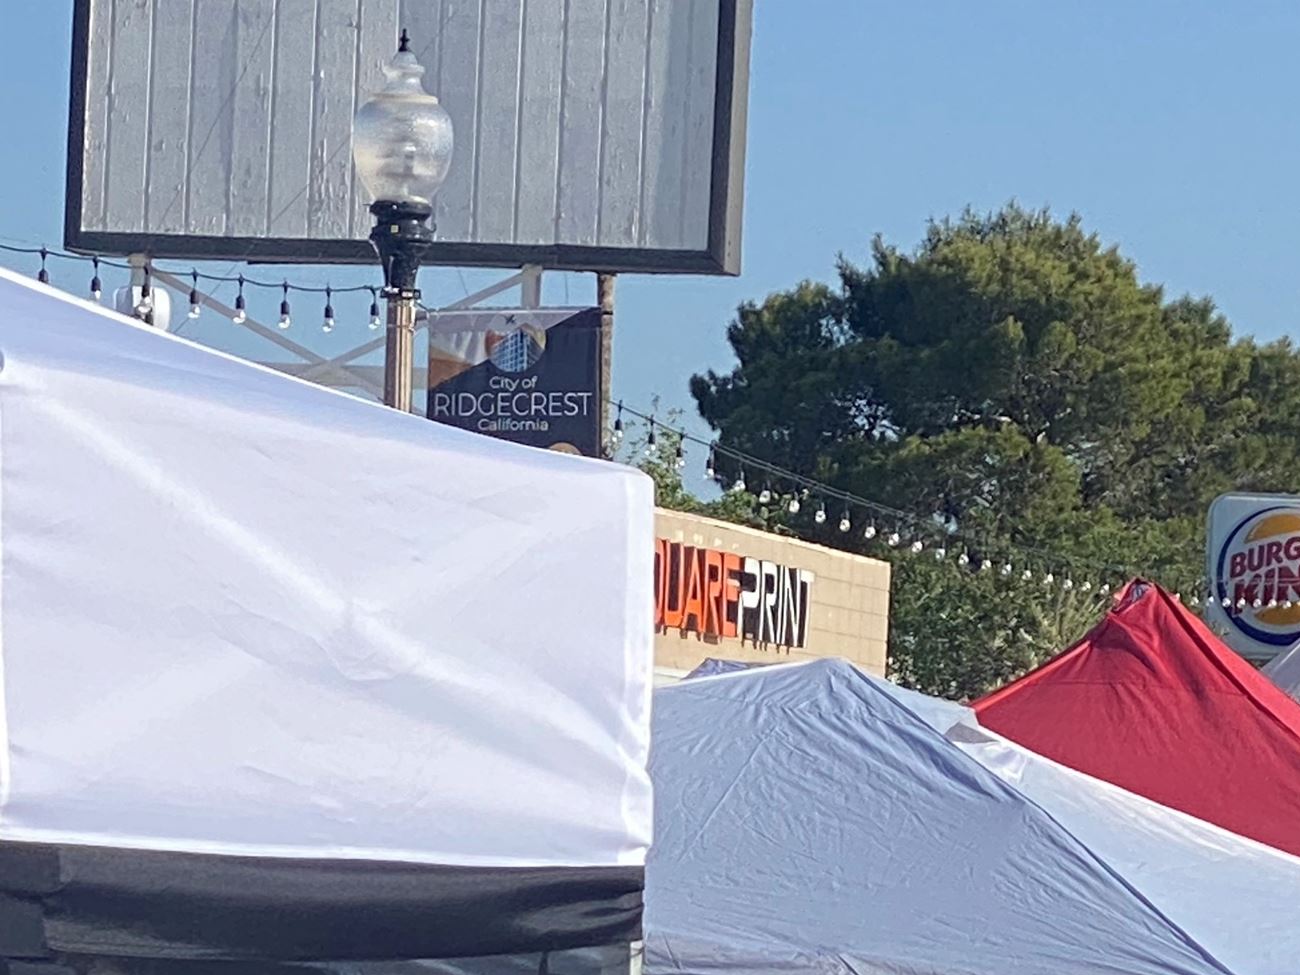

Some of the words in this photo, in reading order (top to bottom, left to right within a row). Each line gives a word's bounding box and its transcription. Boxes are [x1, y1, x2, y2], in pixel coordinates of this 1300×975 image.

[489, 375, 520, 392] City
[521, 375, 538, 390] of
[434, 392, 593, 417] RIDGECREST
[477, 418, 550, 432] California
